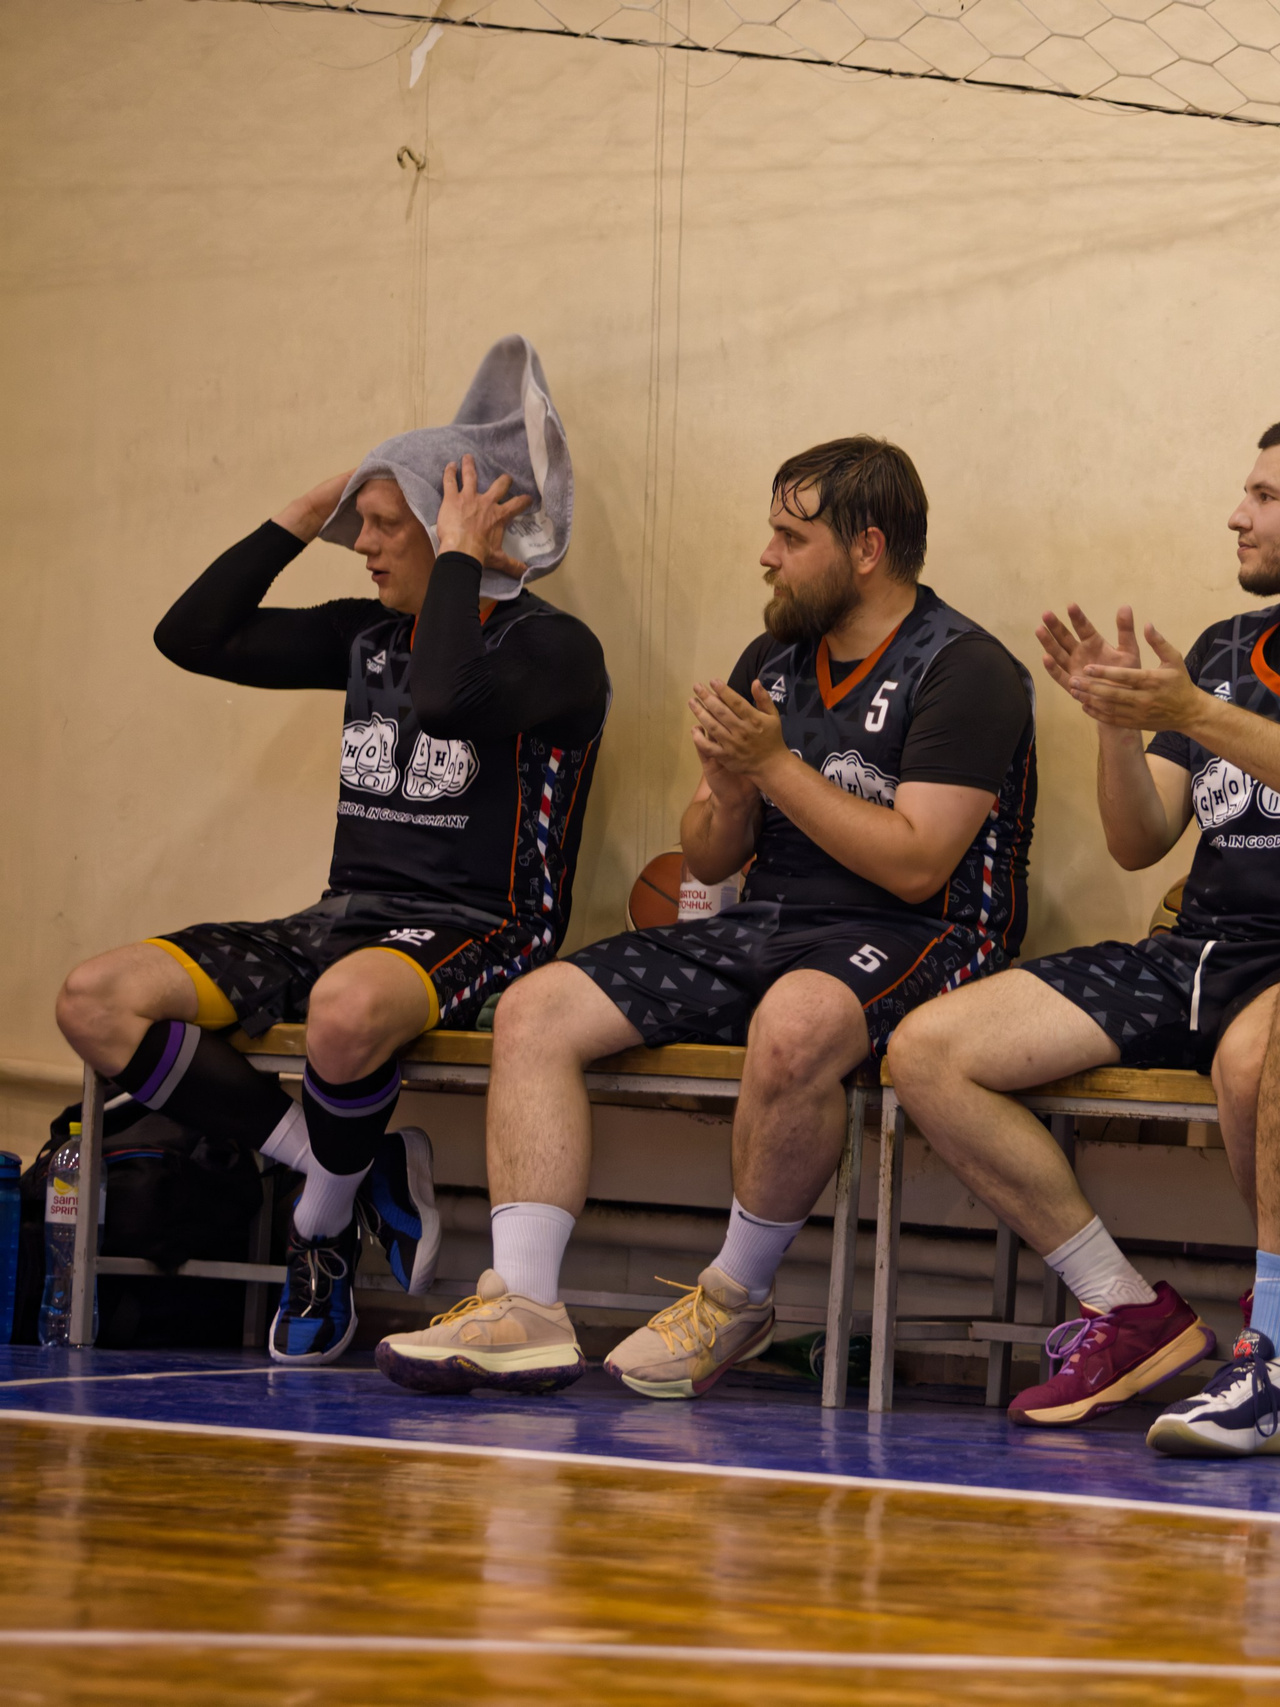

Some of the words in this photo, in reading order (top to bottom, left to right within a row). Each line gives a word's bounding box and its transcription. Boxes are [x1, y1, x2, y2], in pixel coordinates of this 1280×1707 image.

[768, 690, 787, 703] EAK
[865, 680, 898, 732] 5
[345, 741, 388, 758] HOP
[1201, 780, 1253, 811] CHO
[365, 807, 381, 820] IN
[380, 808, 413, 823] GOOD
[412, 814, 469, 829] COMPANY
[1228, 835, 1245, 848] IN
